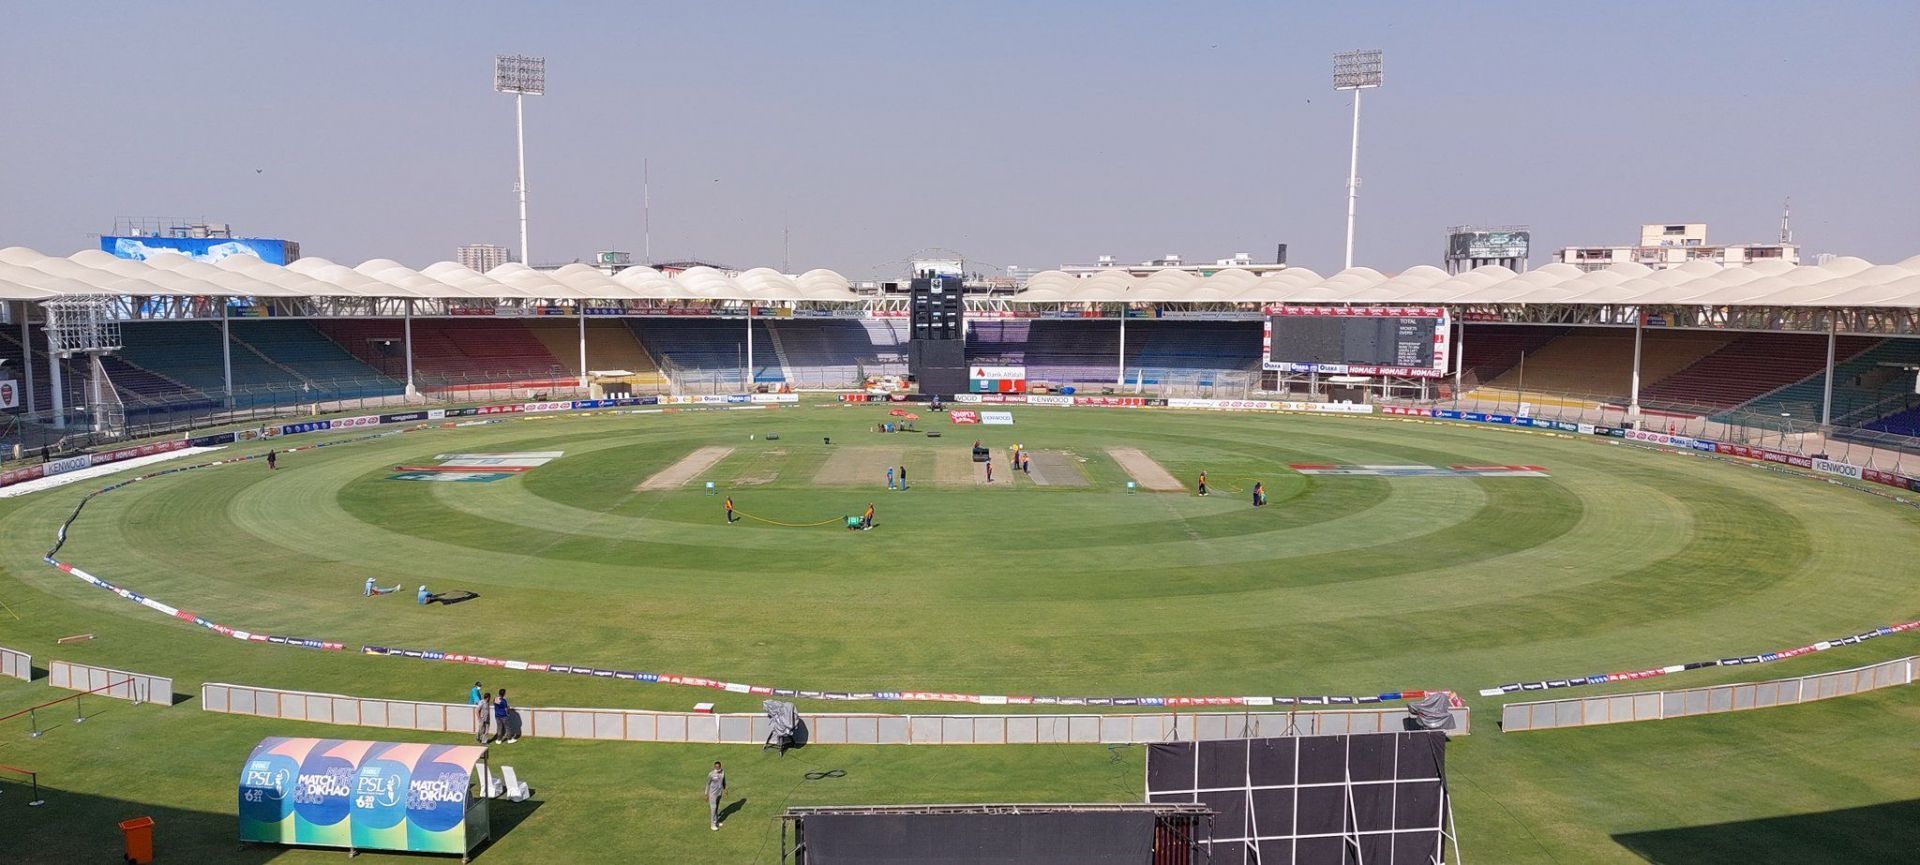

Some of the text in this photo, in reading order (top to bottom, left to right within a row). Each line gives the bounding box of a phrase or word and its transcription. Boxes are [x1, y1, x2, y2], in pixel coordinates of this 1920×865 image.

[1350, 366, 1377, 374] HOMAGE
[1410, 369, 1440, 377] HOMAGE
[93, 449, 138, 464] HOMAGE HOMAGE
[1764, 452, 1812, 469] HOMAGE HOMAGE
[48, 457, 85, 474] KENWOOD
[1816, 461, 1857, 476] KENWOOD
[245, 770, 275, 786] PSL
[298, 774, 336, 785] MATCH
[356, 776, 386, 792] PSL
[307, 784, 350, 797] DIKHAO
[410, 780, 449, 791] MATCH
[244, 789, 253, 801] 6
[355, 795, 365, 808] 6
[420, 790, 463, 802] DIKHAO
